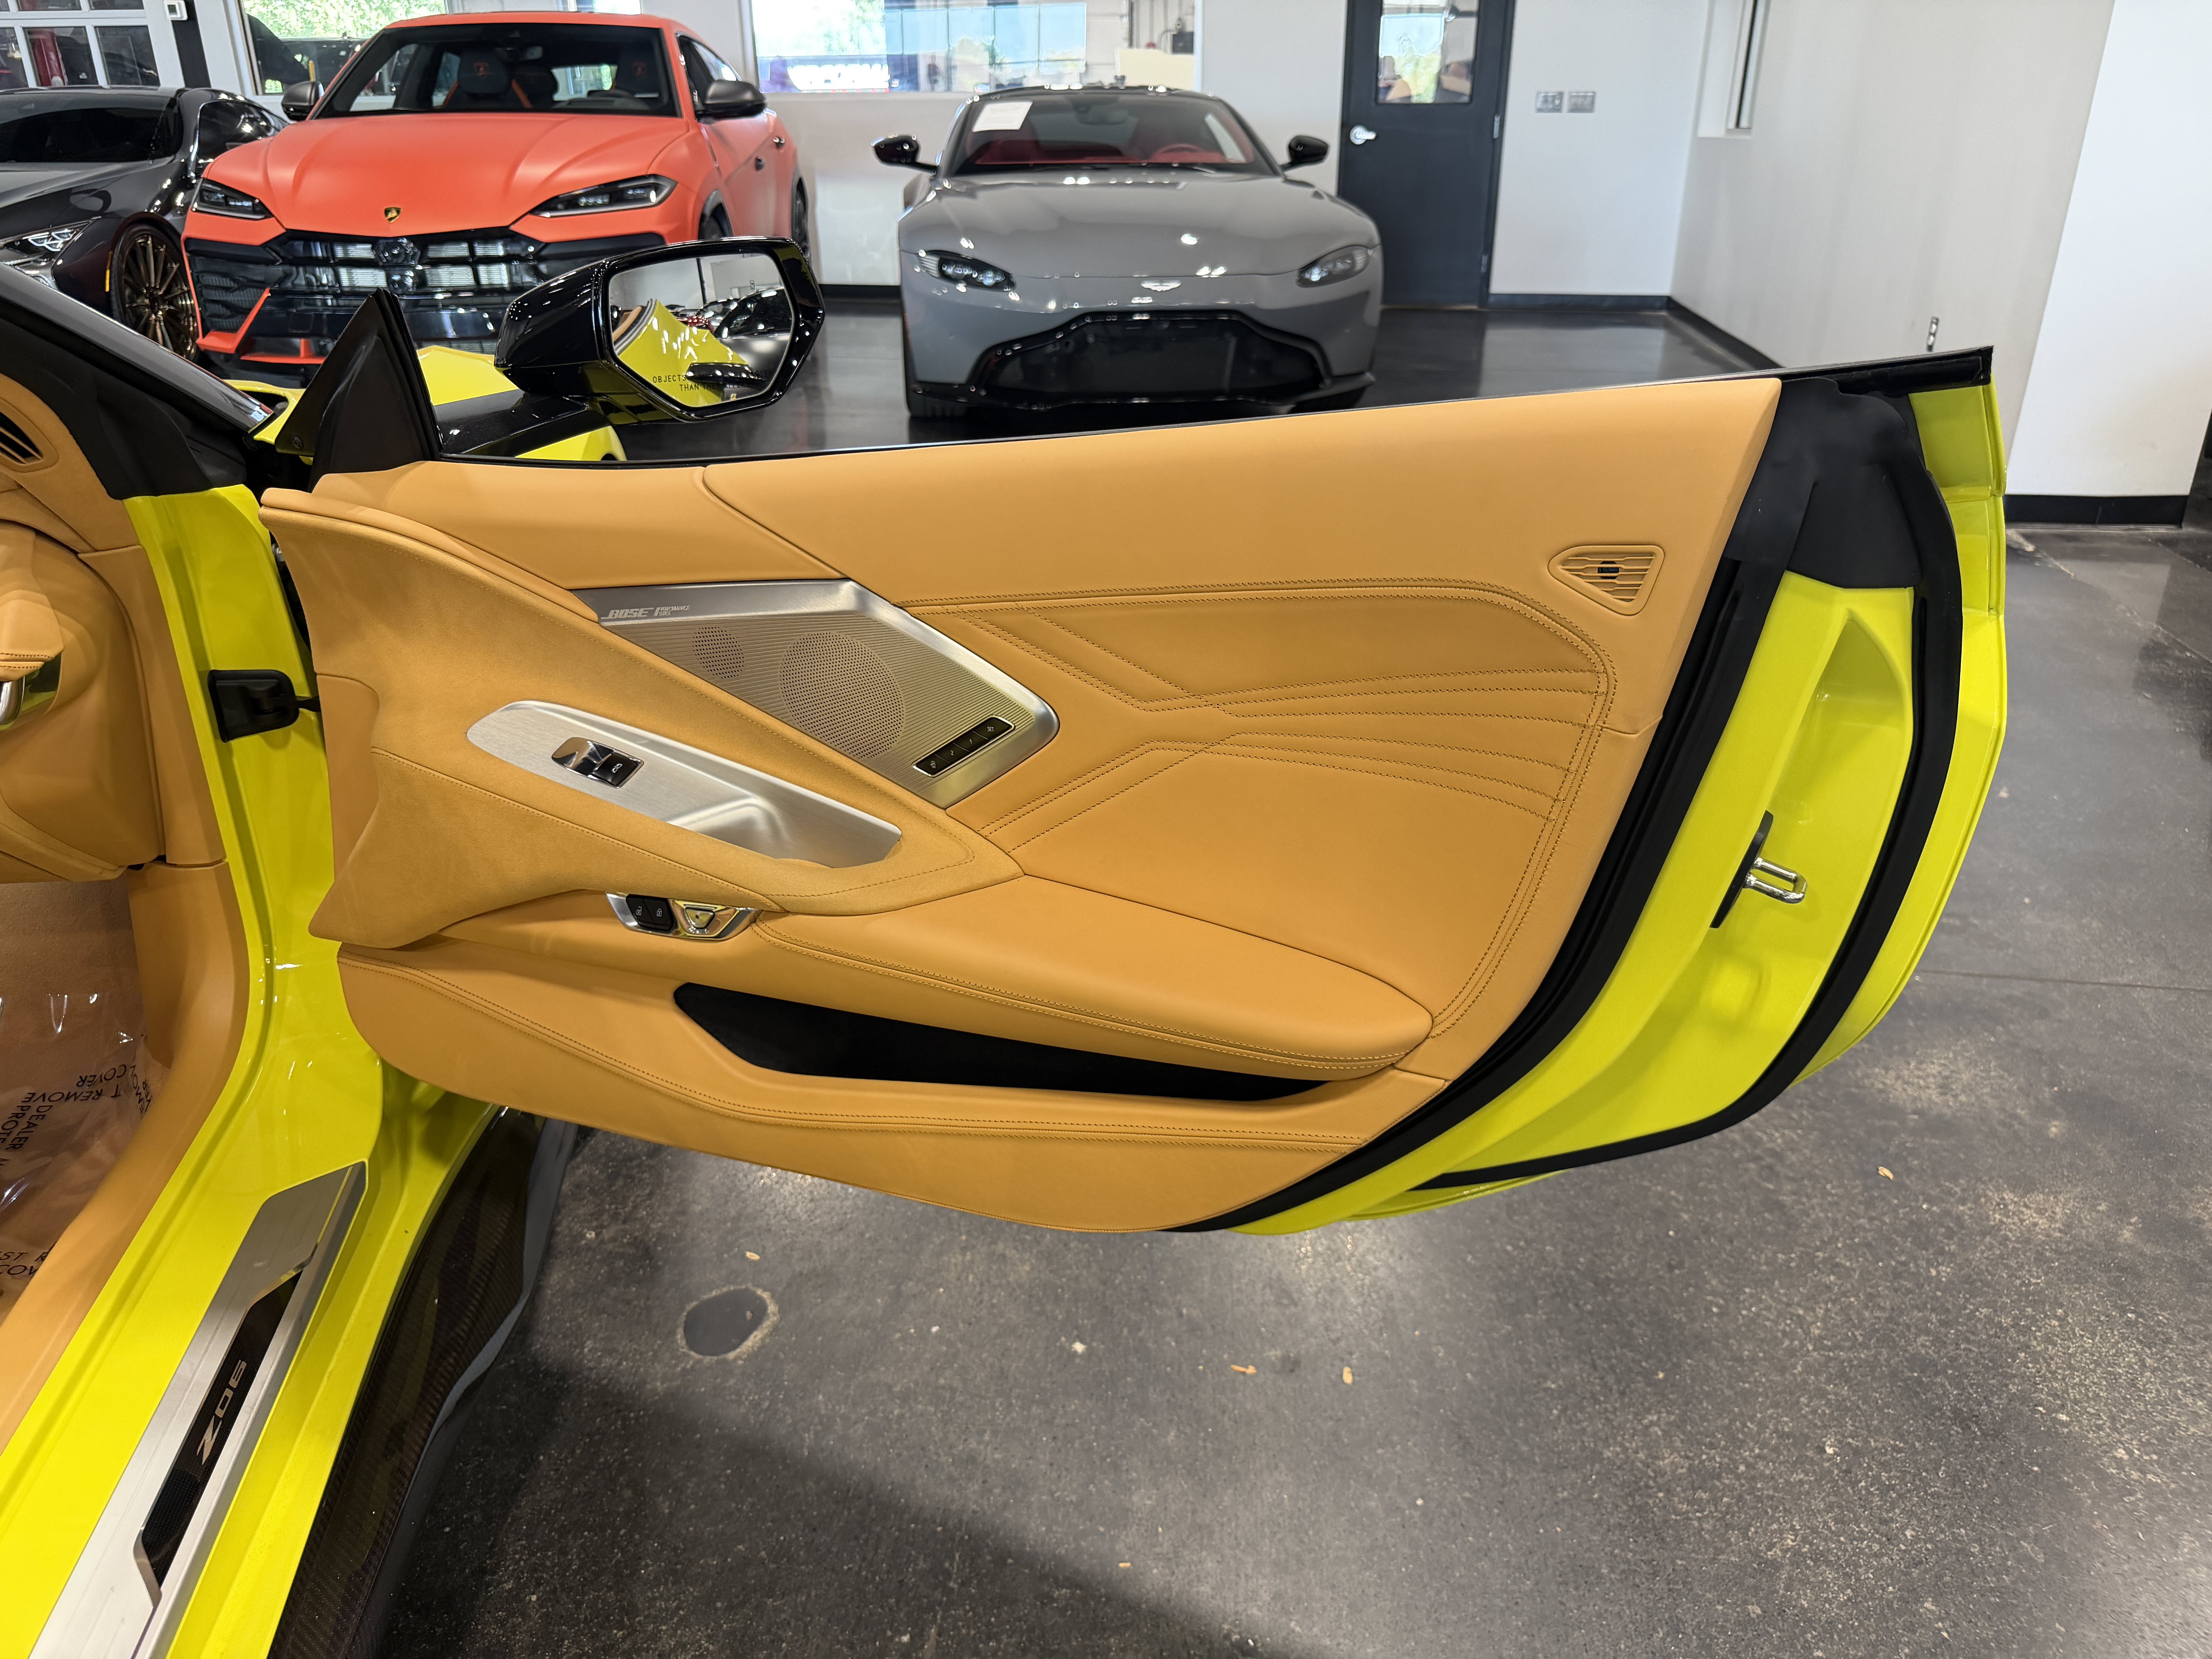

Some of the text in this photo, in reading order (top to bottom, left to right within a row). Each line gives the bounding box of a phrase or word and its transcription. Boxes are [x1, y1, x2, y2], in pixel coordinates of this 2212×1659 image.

[653, 374, 687, 383] OBJECTS
[601, 607, 654, 619] BOSE
[76, 1064, 127, 1087] COVER
[21, 1088, 103, 1103] REMOVE
[5, 1105, 53, 1150] DEALER
[0, 1264, 39, 1276] COV
[196, 1359, 247, 1465] Z06
